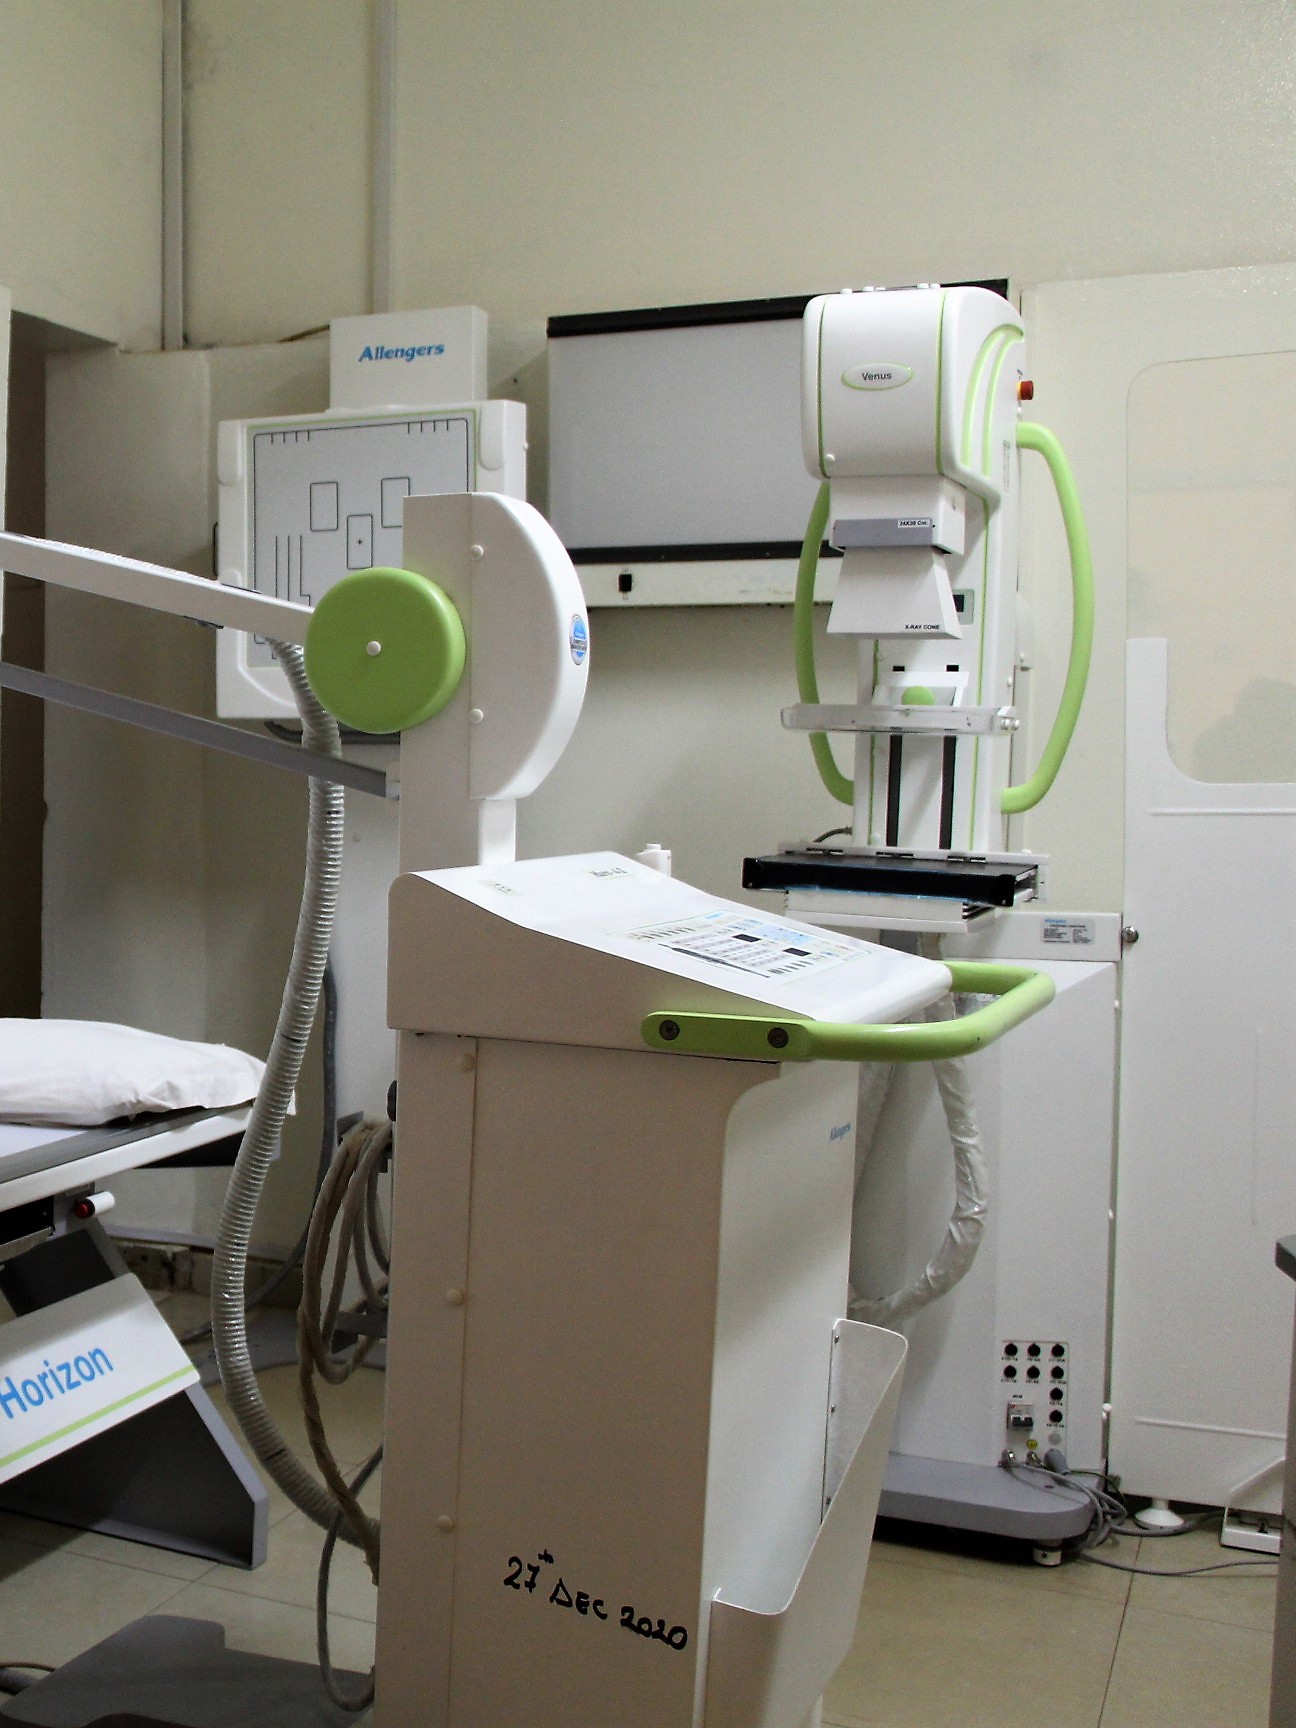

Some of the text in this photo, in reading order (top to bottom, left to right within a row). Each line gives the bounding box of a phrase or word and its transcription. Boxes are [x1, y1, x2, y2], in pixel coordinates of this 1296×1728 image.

[358, 344, 445, 362] Allengers
[862, 372, 892, 381] Venus
[549, 1577, 608, 1620] DEC
[620, 1606, 688, 1650] 2020
